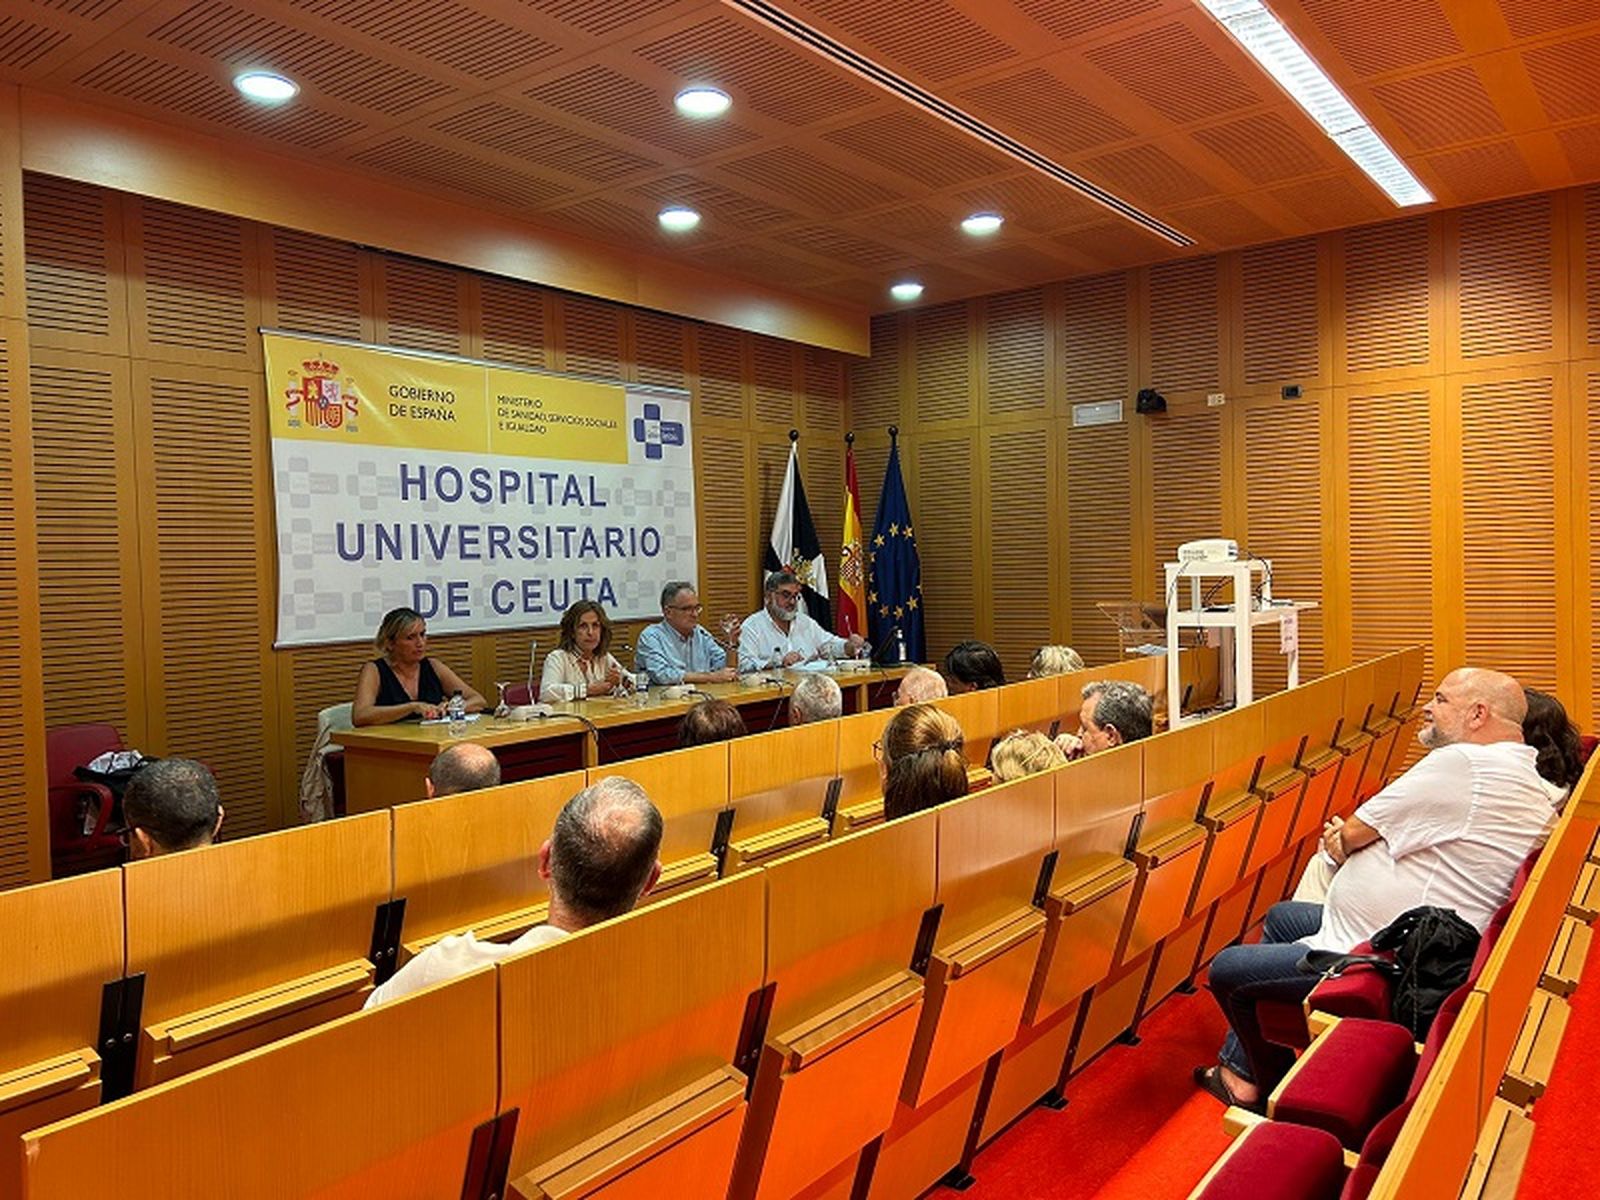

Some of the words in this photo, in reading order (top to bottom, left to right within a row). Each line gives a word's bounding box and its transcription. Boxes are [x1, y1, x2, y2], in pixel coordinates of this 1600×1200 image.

[389, 385, 455, 404] GOBIERNO
[389, 403, 407, 417] DE
[410, 405, 456, 422] ESPAÑA
[400, 463, 607, 507] HOSPITAL
[336, 522, 661, 561] UNIVERSITARIO
[412, 582, 471, 619] DE
[491, 577, 618, 616] CEUTA
